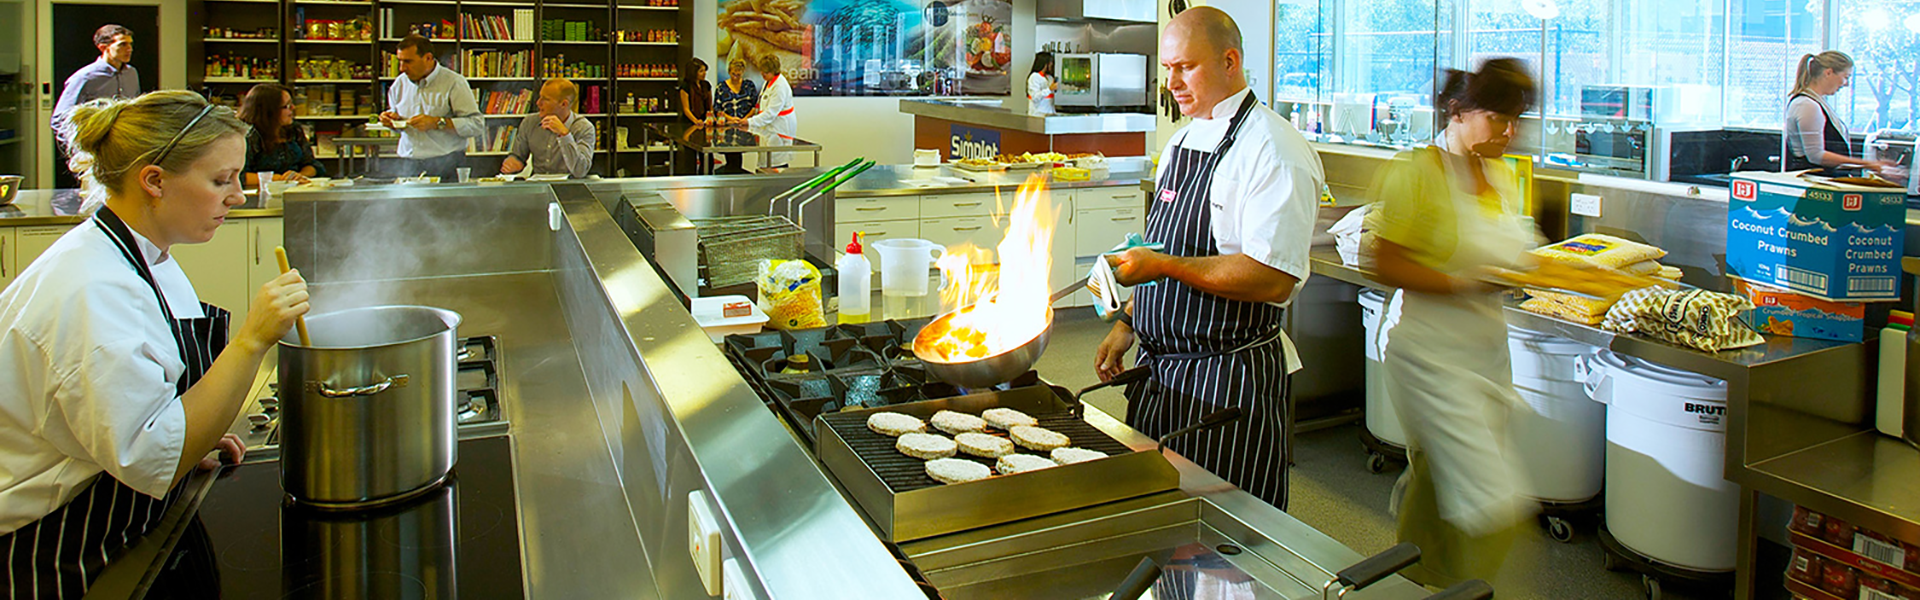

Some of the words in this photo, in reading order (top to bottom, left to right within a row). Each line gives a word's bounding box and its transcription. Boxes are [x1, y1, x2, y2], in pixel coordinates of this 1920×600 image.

[951, 135, 998, 160] Simplot
[1731, 219, 1774, 236] Coconut
[1777, 227, 1829, 246] Crumbed
[1847, 235, 1893, 246] Coconut
[1757, 239, 1798, 257] Prawns
[1845, 249, 1894, 259] Crumbed
[1848, 263, 1888, 273] Prawns
[1684, 402, 1727, 416] BRUT
